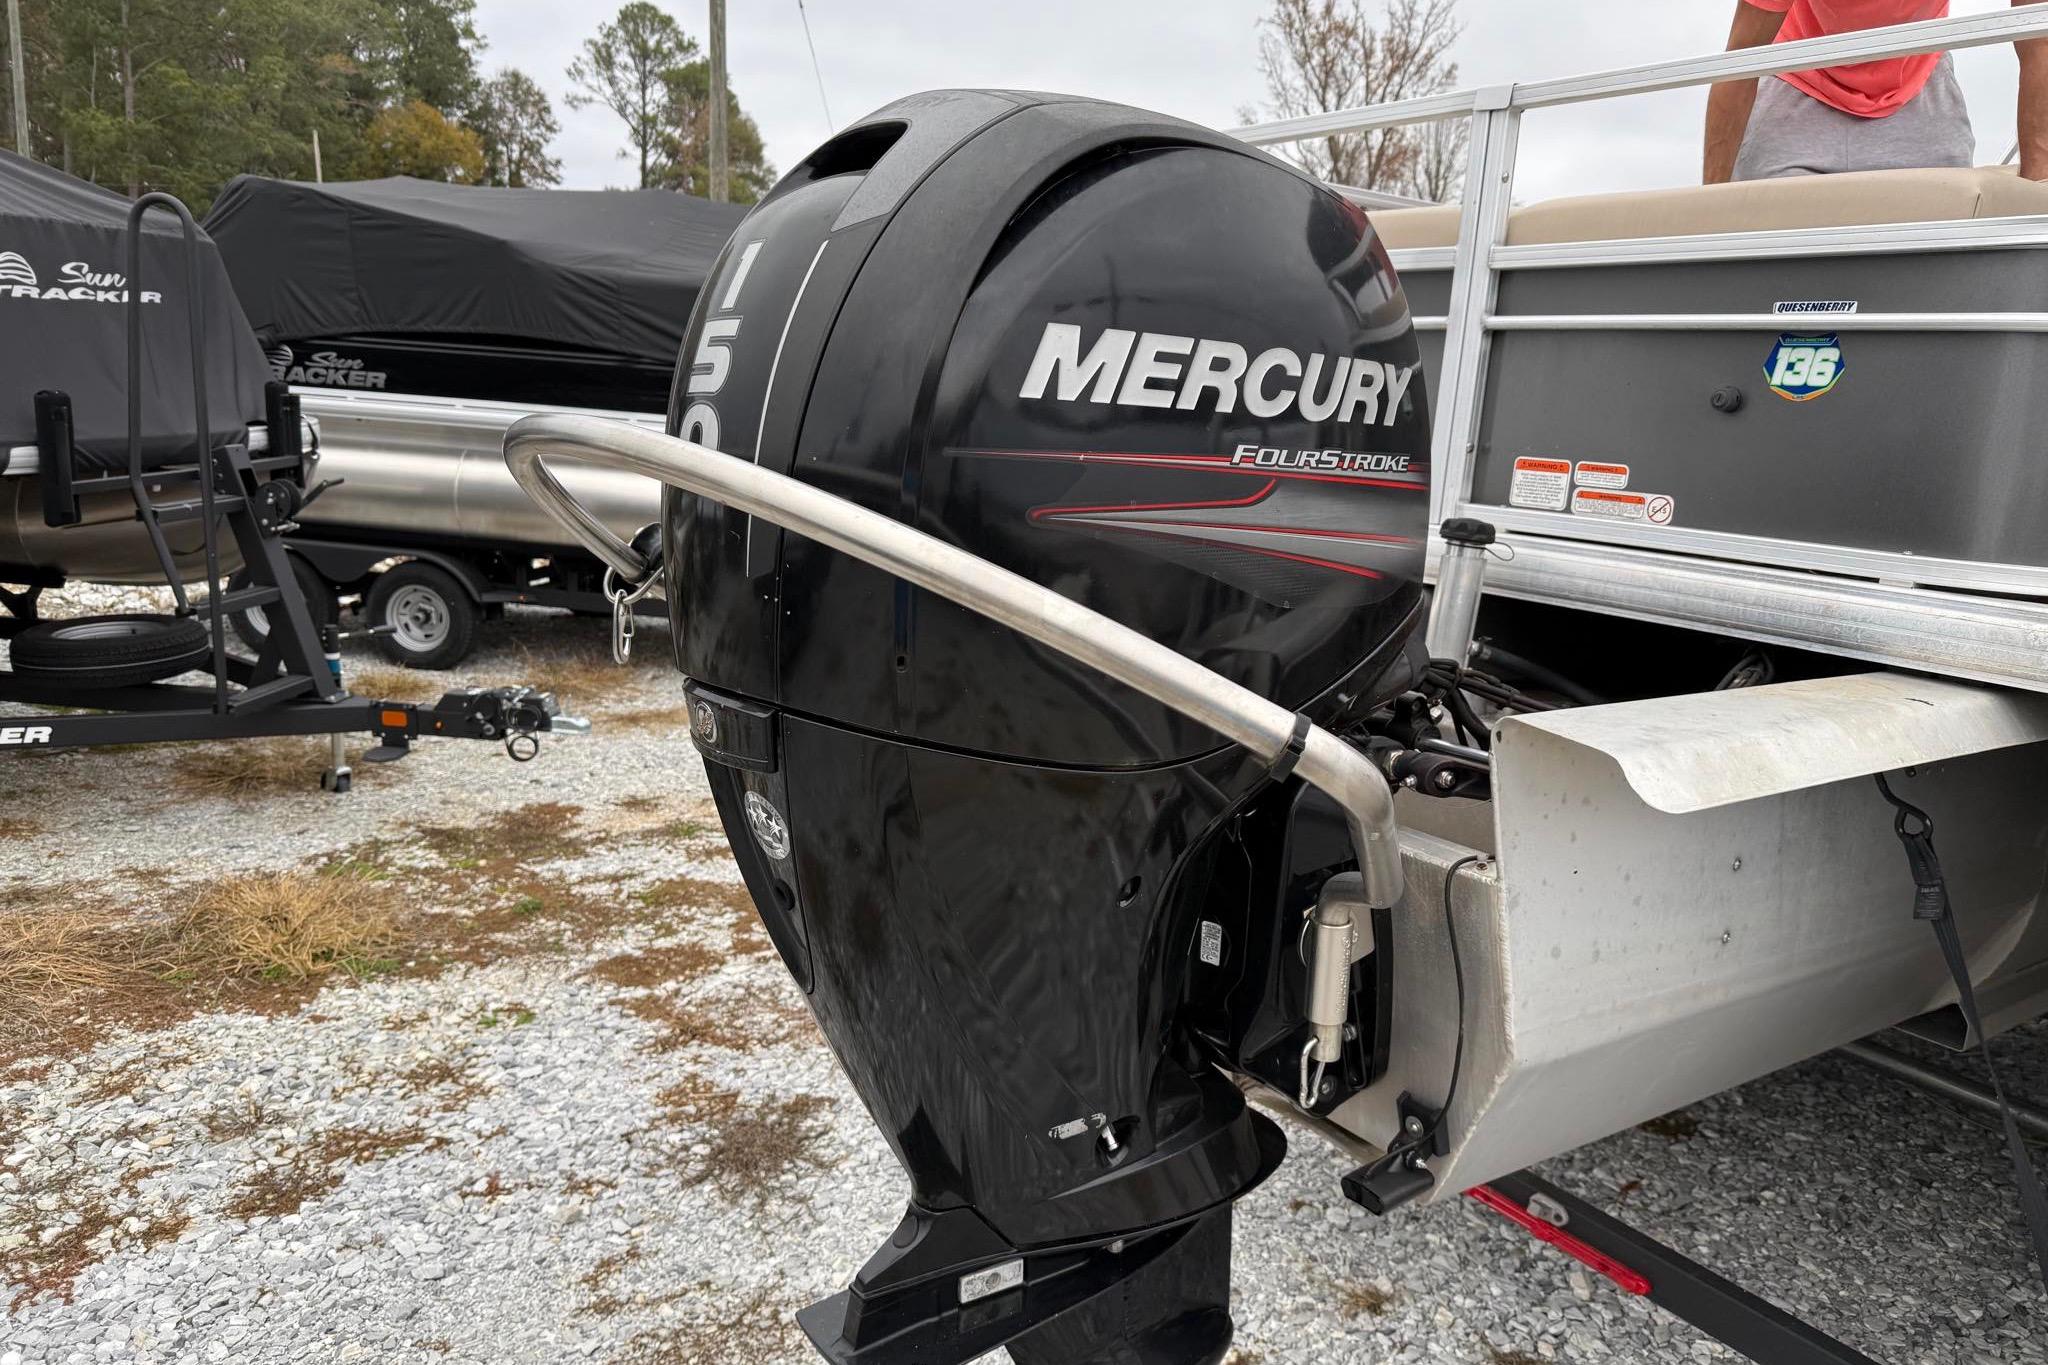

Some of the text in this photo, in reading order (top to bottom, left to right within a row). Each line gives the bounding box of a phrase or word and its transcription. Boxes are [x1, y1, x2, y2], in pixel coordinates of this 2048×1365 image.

[57, 262, 126, 287] Sun
[1777, 302, 1855, 313] QUESENBERRY
[304, 351, 364, 370] Sun
[1769, 346, 1841, 387] 136
[270, 365, 387, 388] RACKER
[1019, 322, 1413, 427] MERCURY
[1527, 462, 1558, 471] WARNING
